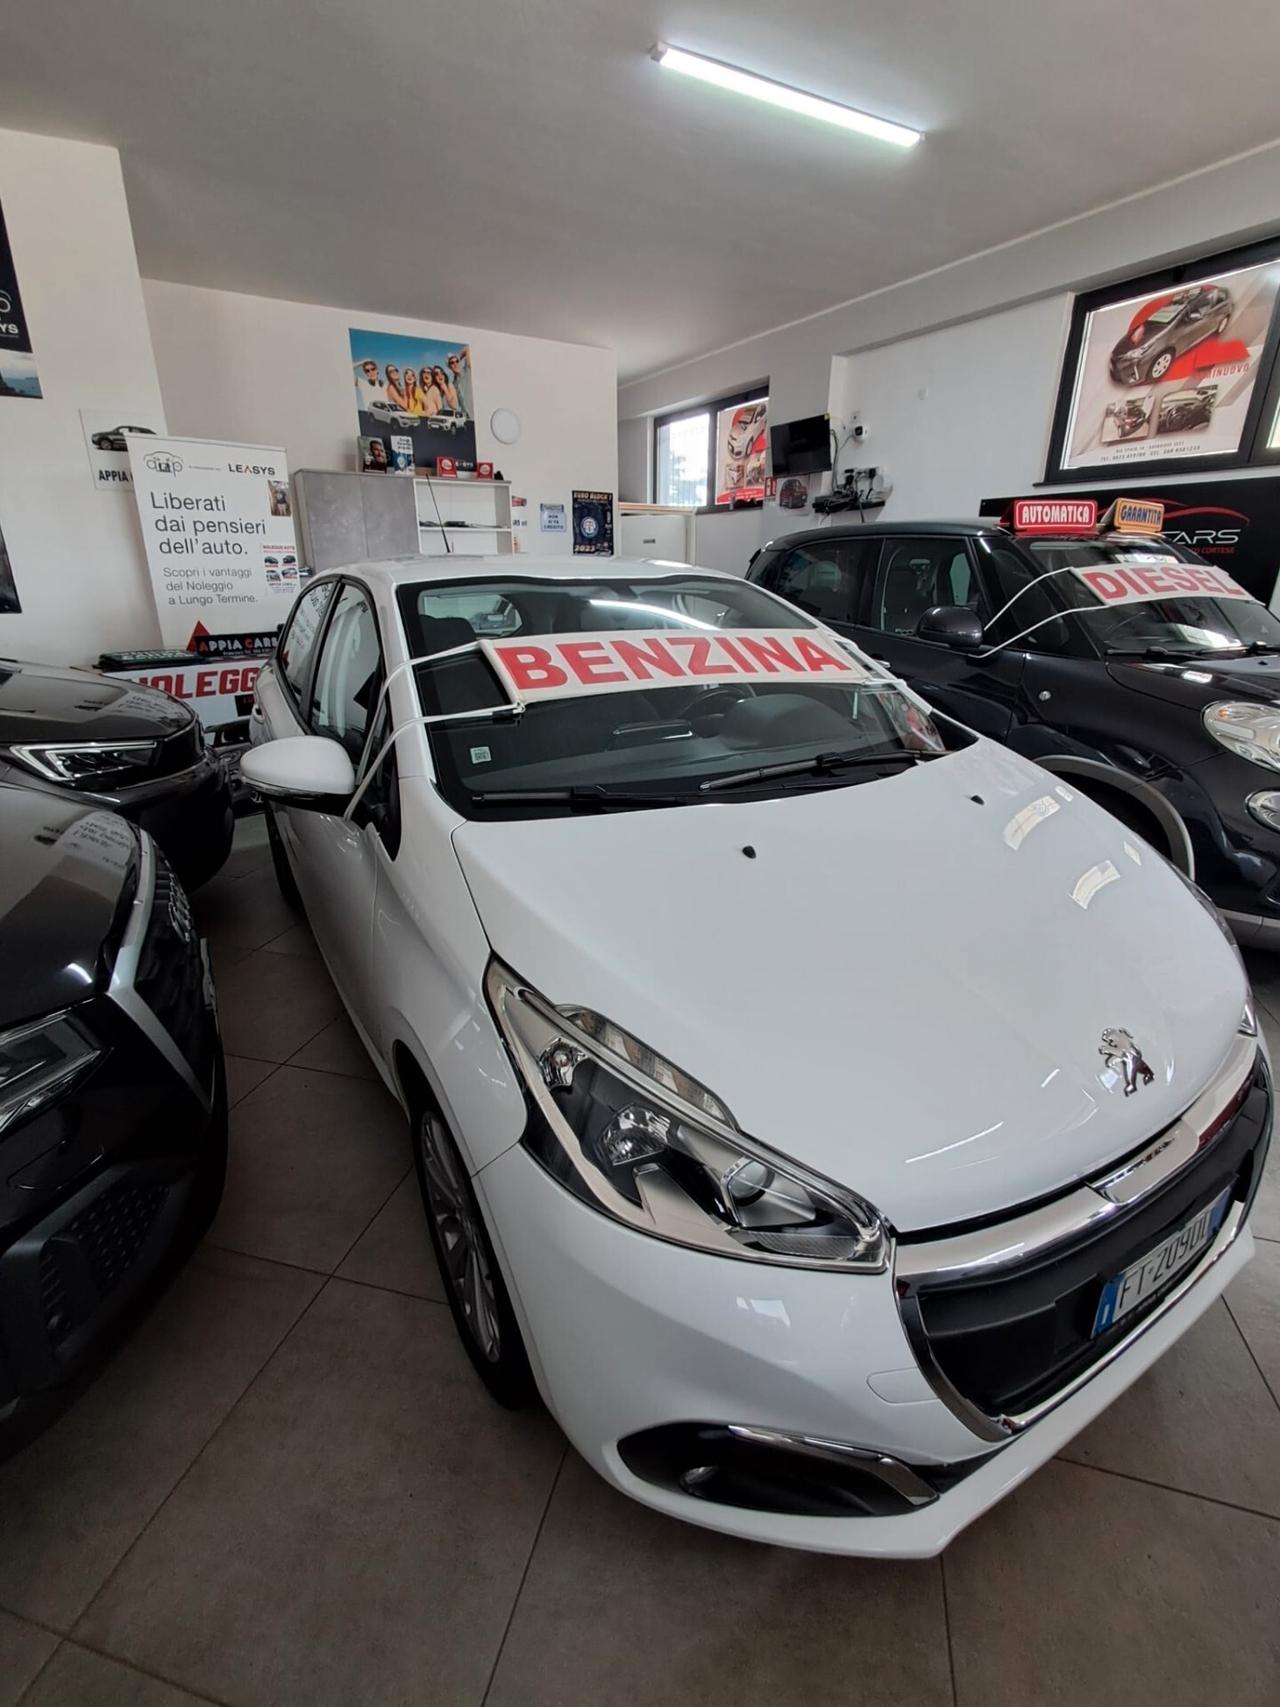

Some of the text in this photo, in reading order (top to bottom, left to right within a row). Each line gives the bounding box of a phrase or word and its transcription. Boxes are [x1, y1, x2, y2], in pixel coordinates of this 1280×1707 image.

[98, 470, 129, 483] APPIA
[228, 463, 276, 476] LEASYS
[150, 491, 226, 512] Liberati
[1022, 505, 1090, 524] AUTOMATICA
[155, 515, 266, 536] dai pensieri
[159, 537, 248, 555] dell'auto.
[163, 567, 199, 580] Scopri
[209, 566, 252, 579] vantaggi
[166, 580, 233, 593] del Noleggio
[1082, 566, 1246, 600] DIESEL
[168, 593, 258, 607] a Lungo Termine.
[202, 638, 243, 653] APPIA
[244, 636, 279, 649] CARS
[494, 636, 853, 690] BENZINA
